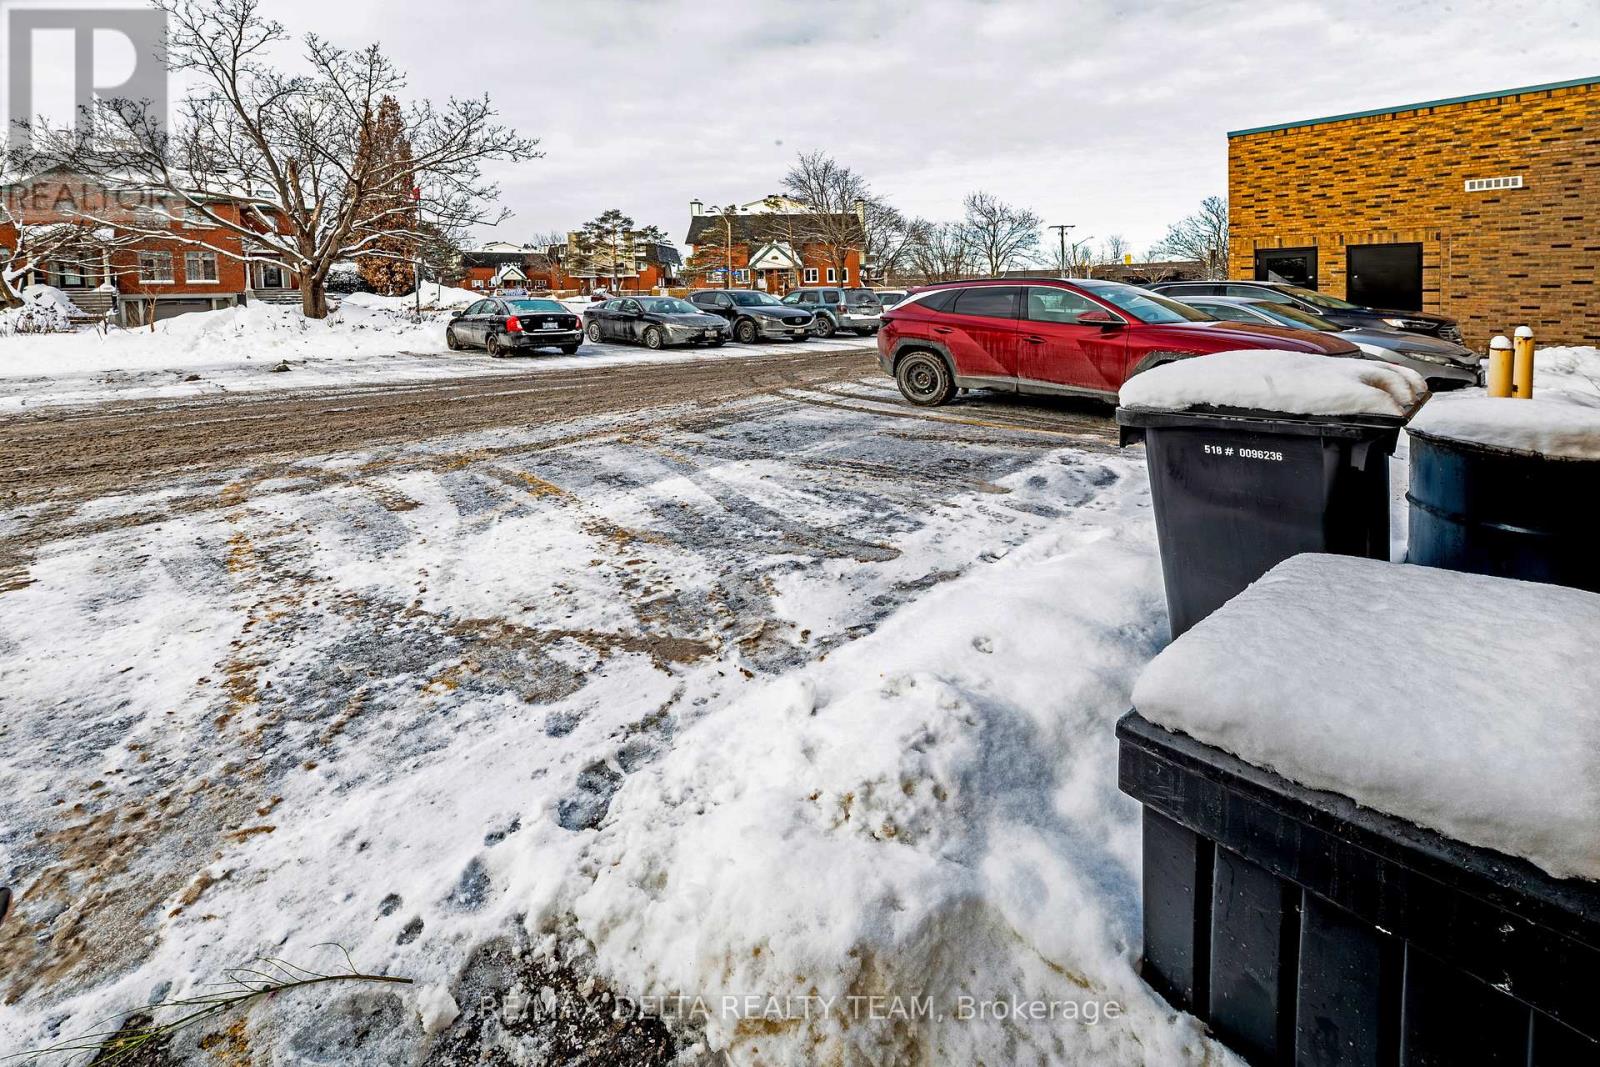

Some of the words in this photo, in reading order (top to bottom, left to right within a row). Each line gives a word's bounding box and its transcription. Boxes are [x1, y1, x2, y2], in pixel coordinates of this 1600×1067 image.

[1204, 445, 1222, 455] 518
[1225, 447, 1234, 456] #
[1239, 448, 1283, 461] 0096236
